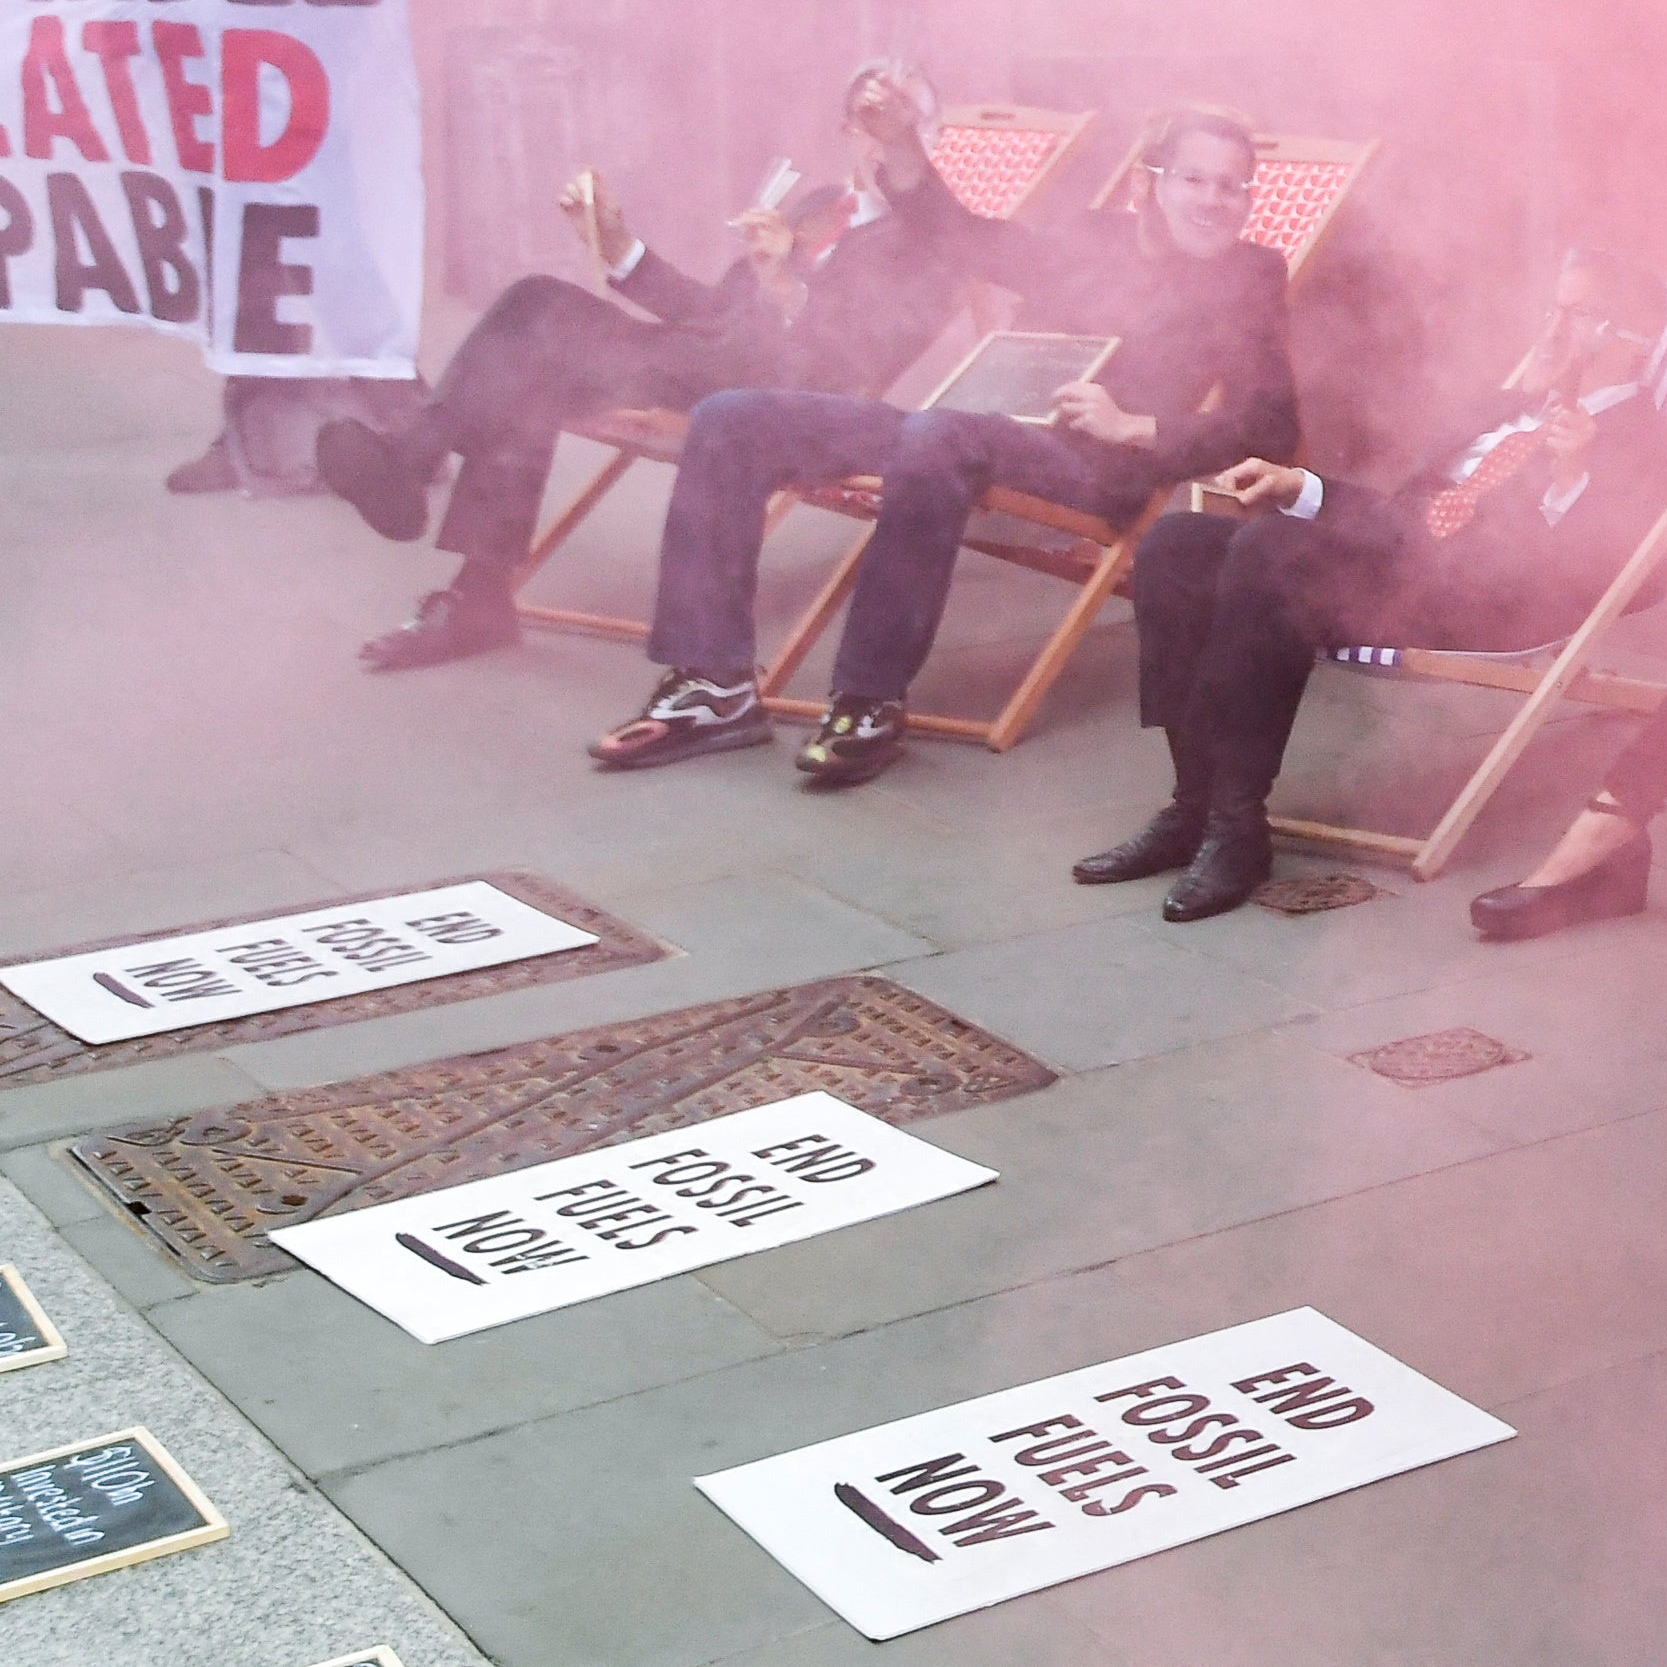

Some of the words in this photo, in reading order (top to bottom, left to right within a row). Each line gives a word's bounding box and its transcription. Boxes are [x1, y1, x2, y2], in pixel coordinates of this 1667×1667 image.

[0, 14, 331, 184] ATED
[302, 918, 434, 973] FOSSIL
[405, 911, 505, 945] END
[124, 957, 245, 1002] NOW
[214, 938, 341, 988] FUELS
[627, 1148, 805, 1228] FOSSIL
[751, 1133, 877, 1184] END
[431, 1209, 591, 1275] NOW
[533, 1179, 700, 1251] FUELS
[1229, 1361, 1376, 1430] END
[988, 1413, 1180, 1518] FUELS
[1093, 1375, 1299, 1491] FOSSIL
[874, 1452, 1057, 1548] NOW
